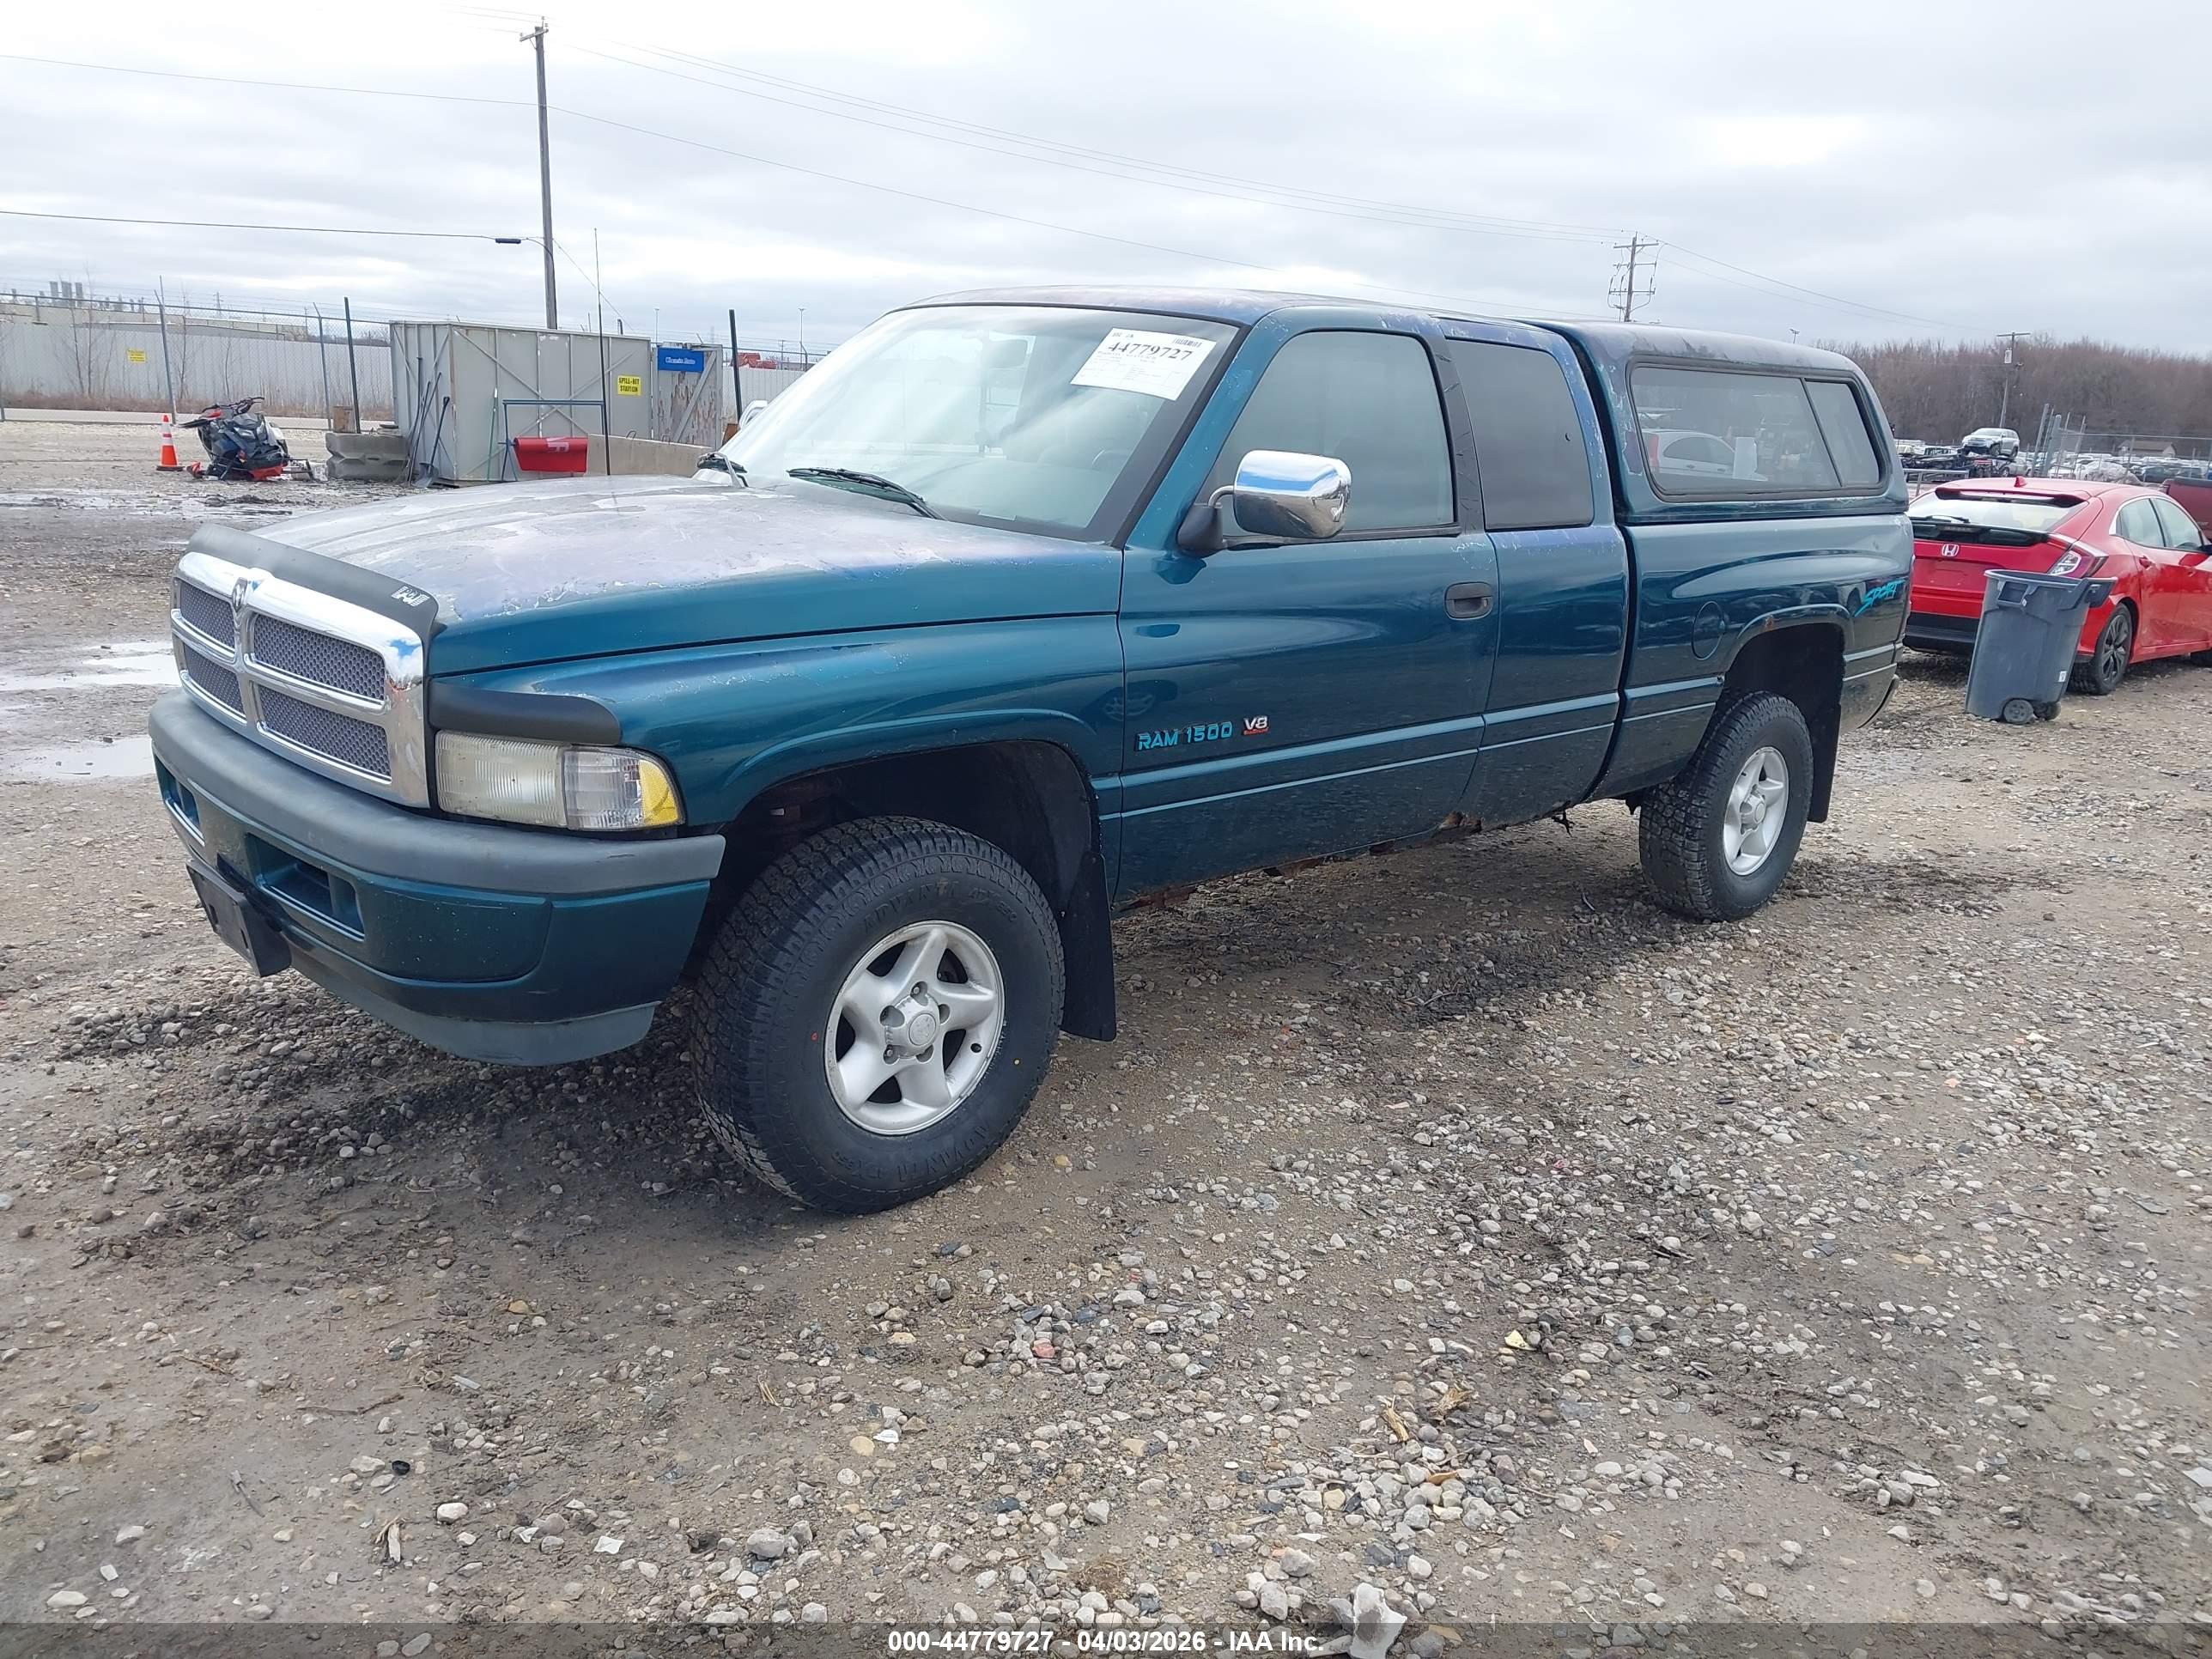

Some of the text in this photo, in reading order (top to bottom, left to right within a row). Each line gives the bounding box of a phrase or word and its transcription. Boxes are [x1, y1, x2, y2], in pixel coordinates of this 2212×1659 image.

[1108, 342, 1193, 361] 44779727
[1137, 714, 1268, 750] RAM 1500 V8
